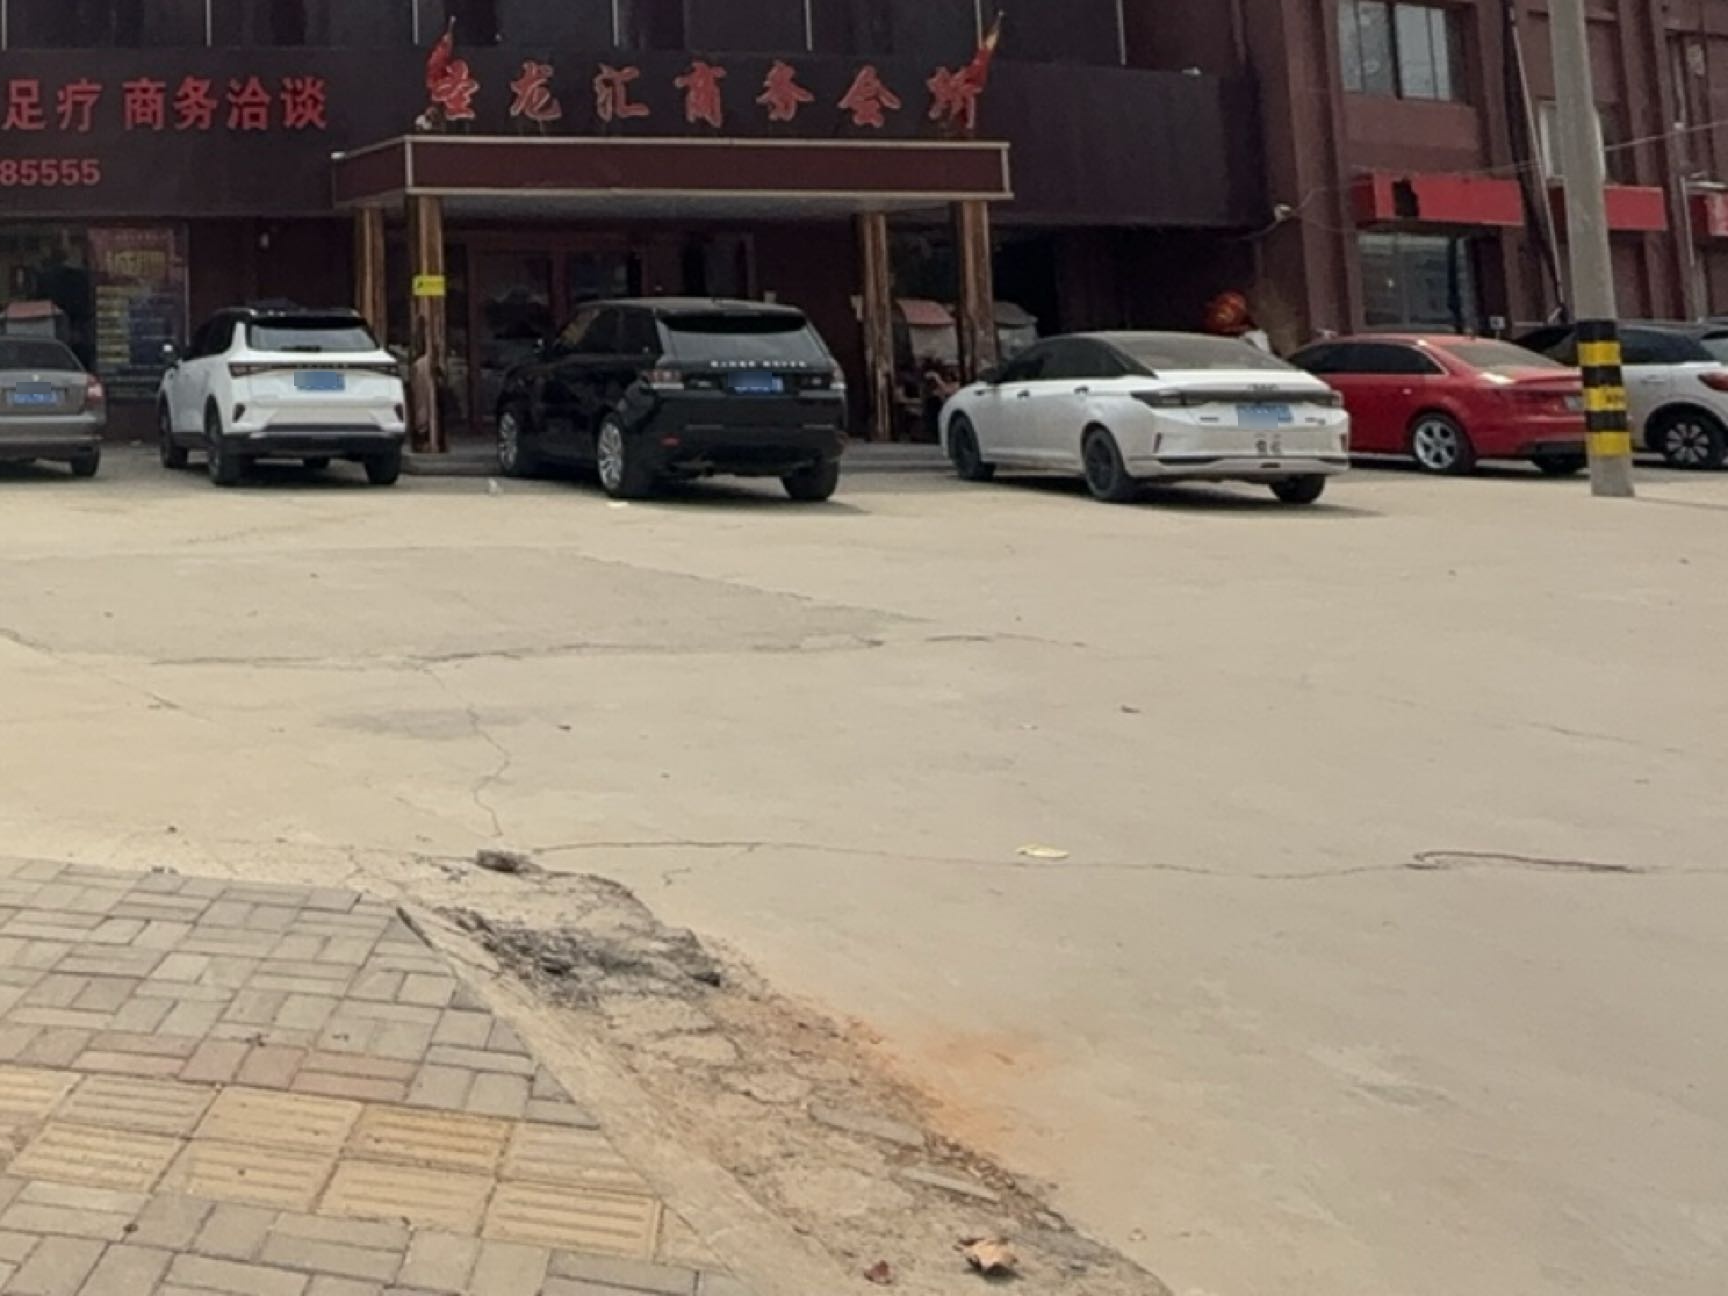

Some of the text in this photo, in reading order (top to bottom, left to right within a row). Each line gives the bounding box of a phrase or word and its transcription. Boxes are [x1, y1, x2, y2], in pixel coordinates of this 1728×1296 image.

[1, 77, 103, 132] 足疗
[122, 75, 327, 131] 商务洽谈
